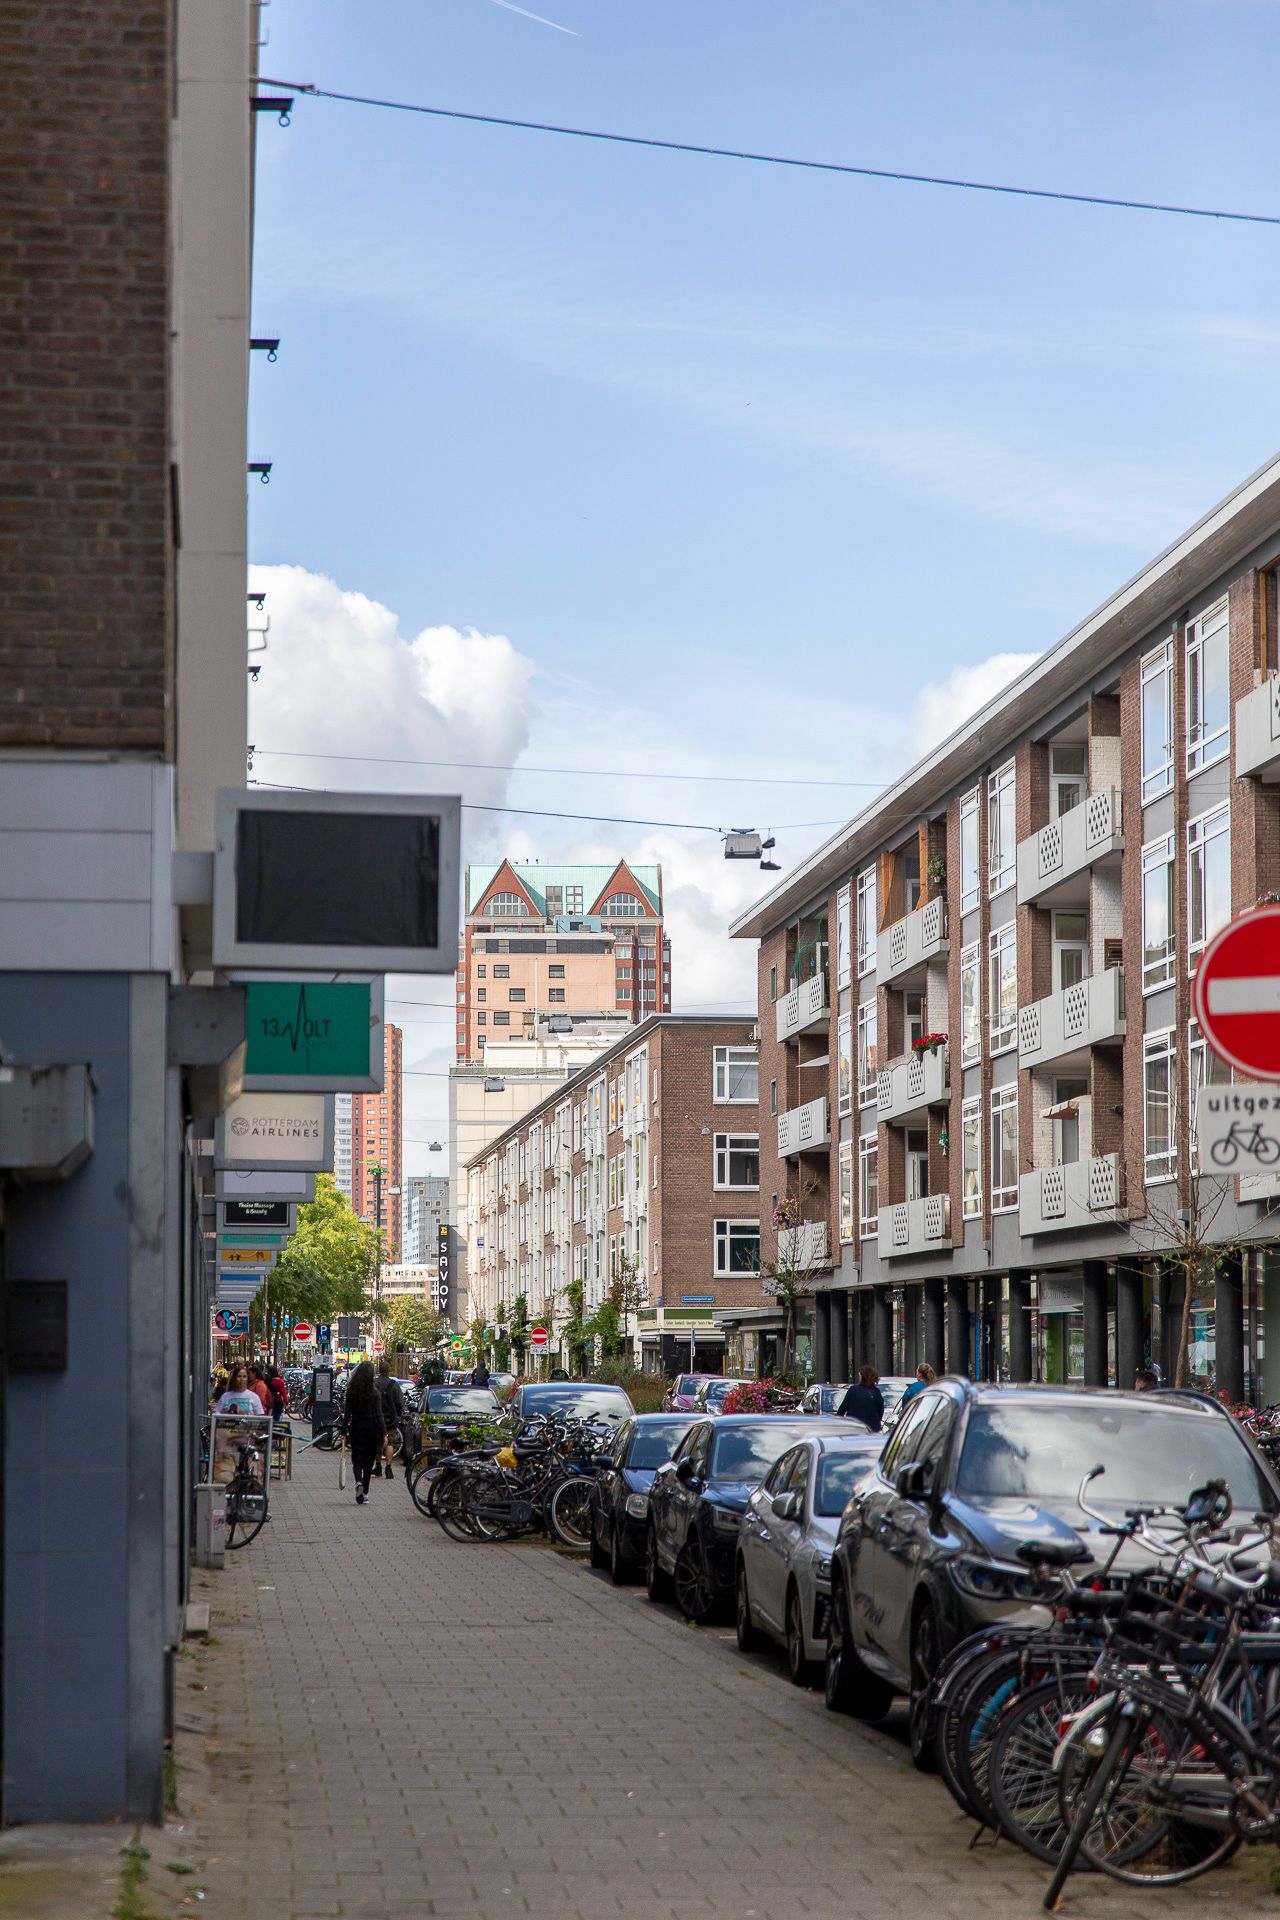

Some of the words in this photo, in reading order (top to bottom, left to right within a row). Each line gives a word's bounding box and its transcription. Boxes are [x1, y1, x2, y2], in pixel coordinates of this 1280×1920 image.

[252, 1118, 318, 1128] ROTTERDAM
[251, 1128, 319, 1138] AIRLINES
[250, 1208, 268, 1216] Beauty
[440, 1242, 449, 1308] SAVOY
[321, 1325, 328, 1335] P
